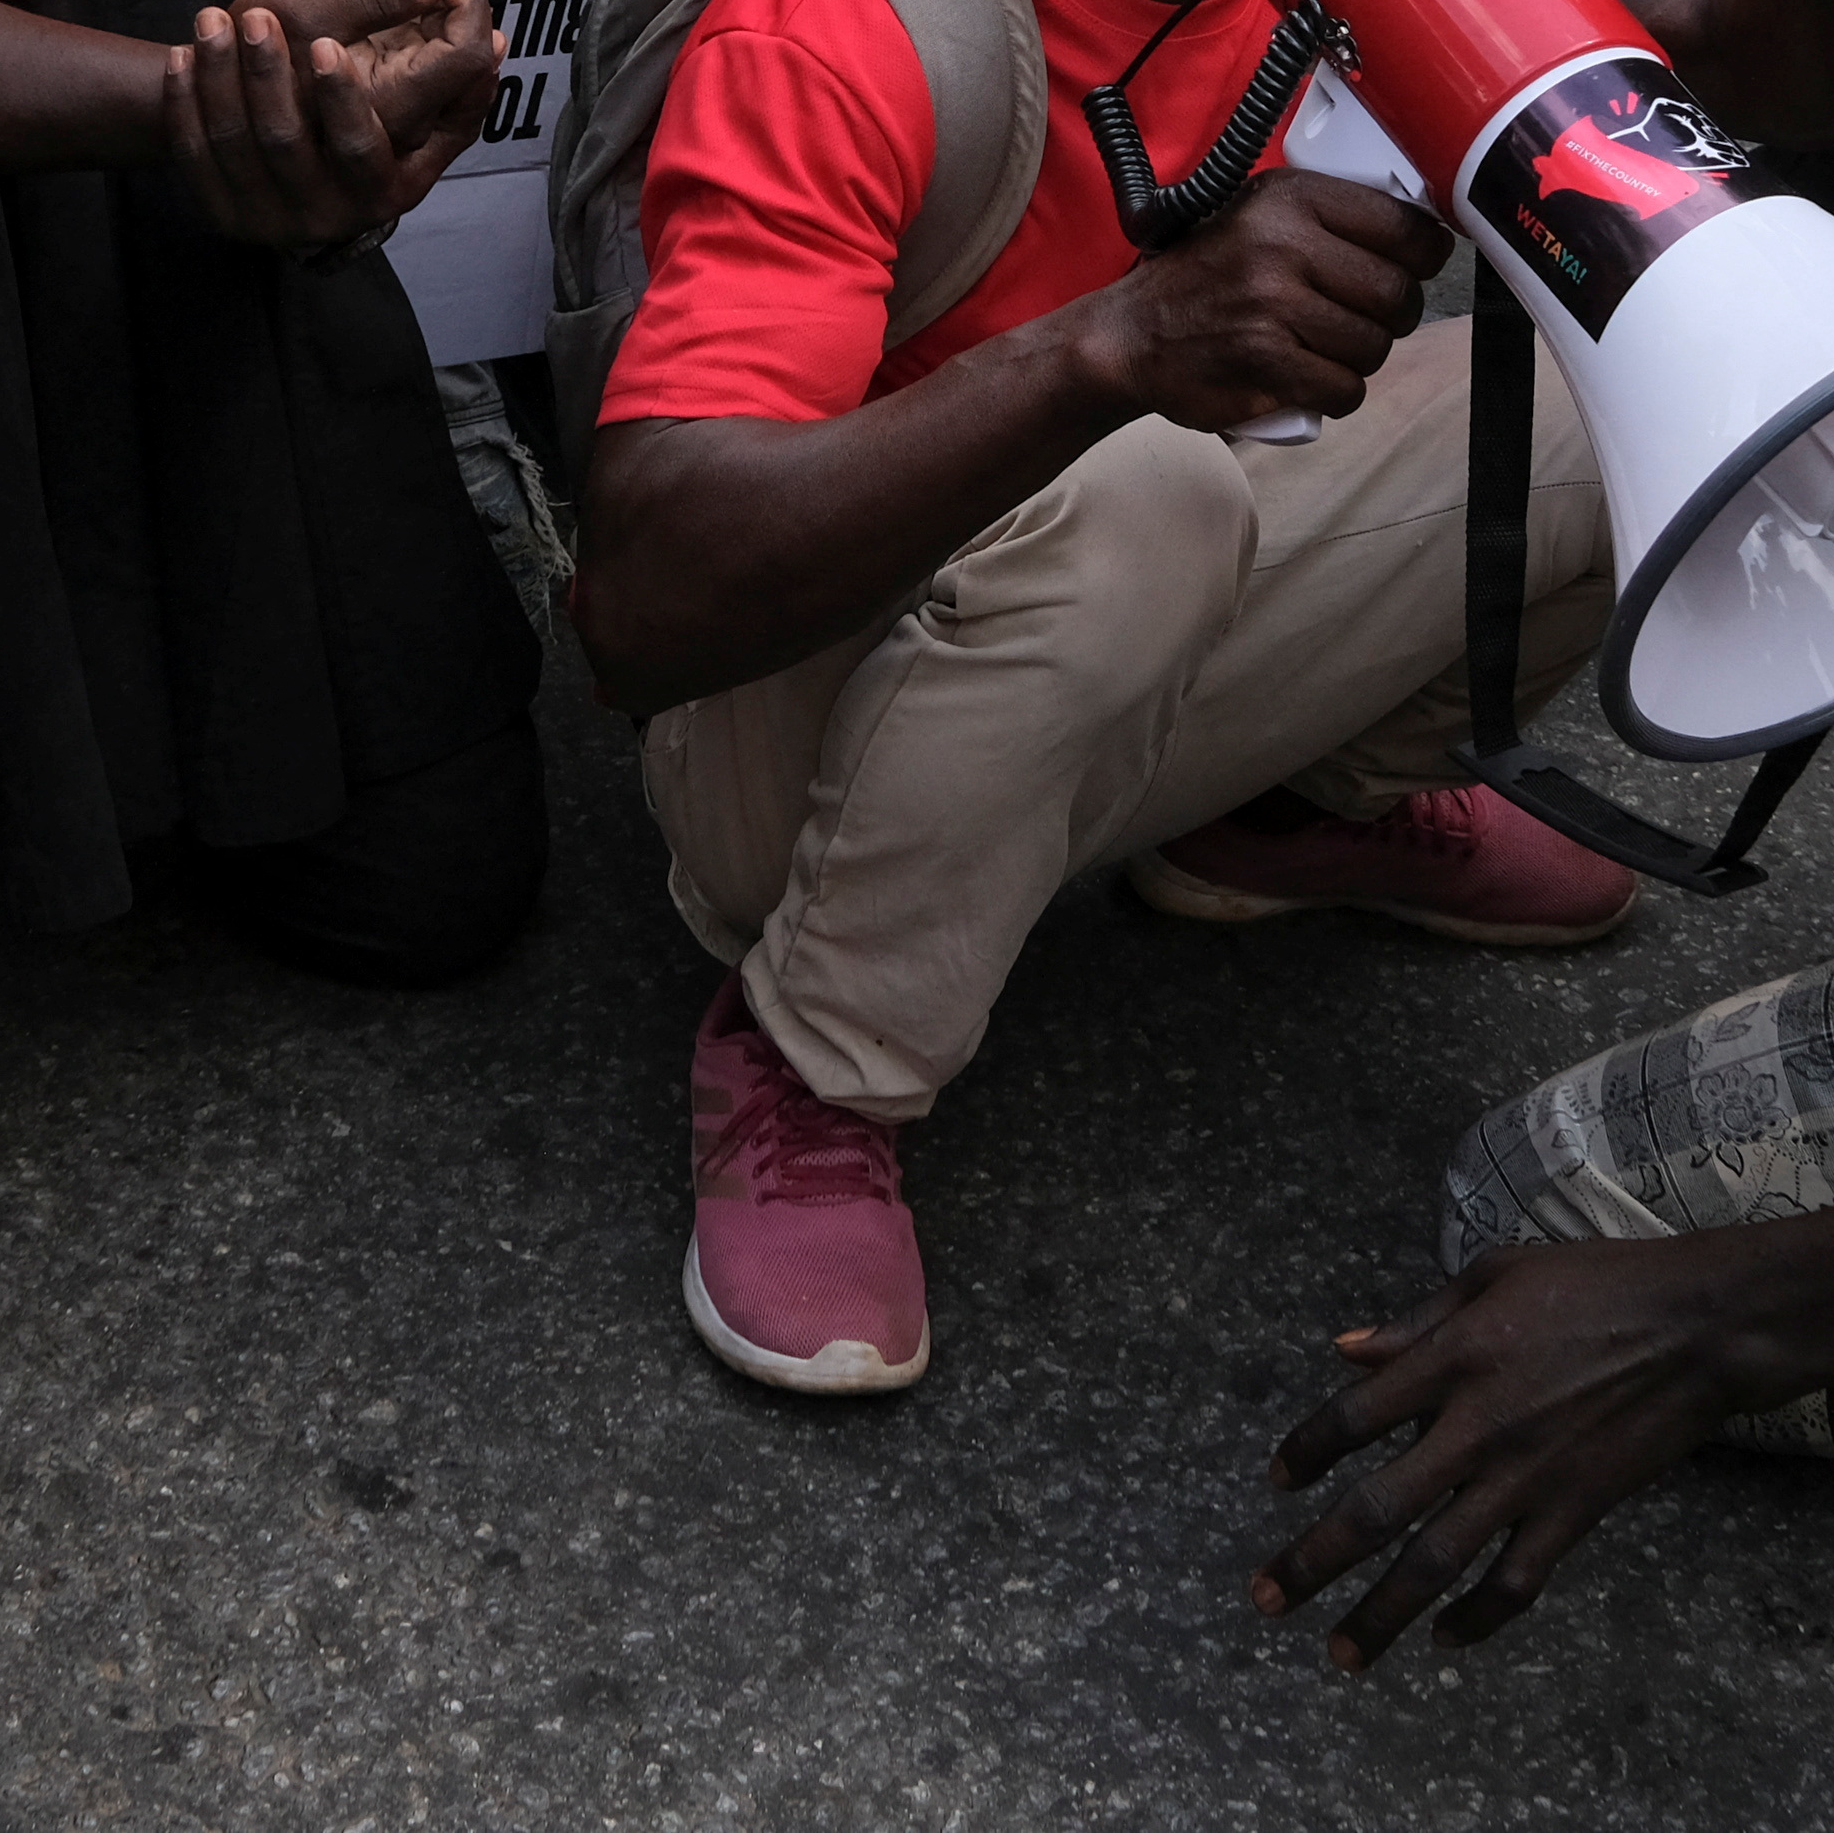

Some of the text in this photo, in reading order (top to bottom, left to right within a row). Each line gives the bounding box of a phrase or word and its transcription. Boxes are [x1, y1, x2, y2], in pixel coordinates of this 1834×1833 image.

[480, 71, 549, 144] TO
[1565, 139, 1662, 199] #FIXTHECOUNTRY
[1516, 202, 1588, 285] WETAYA!
